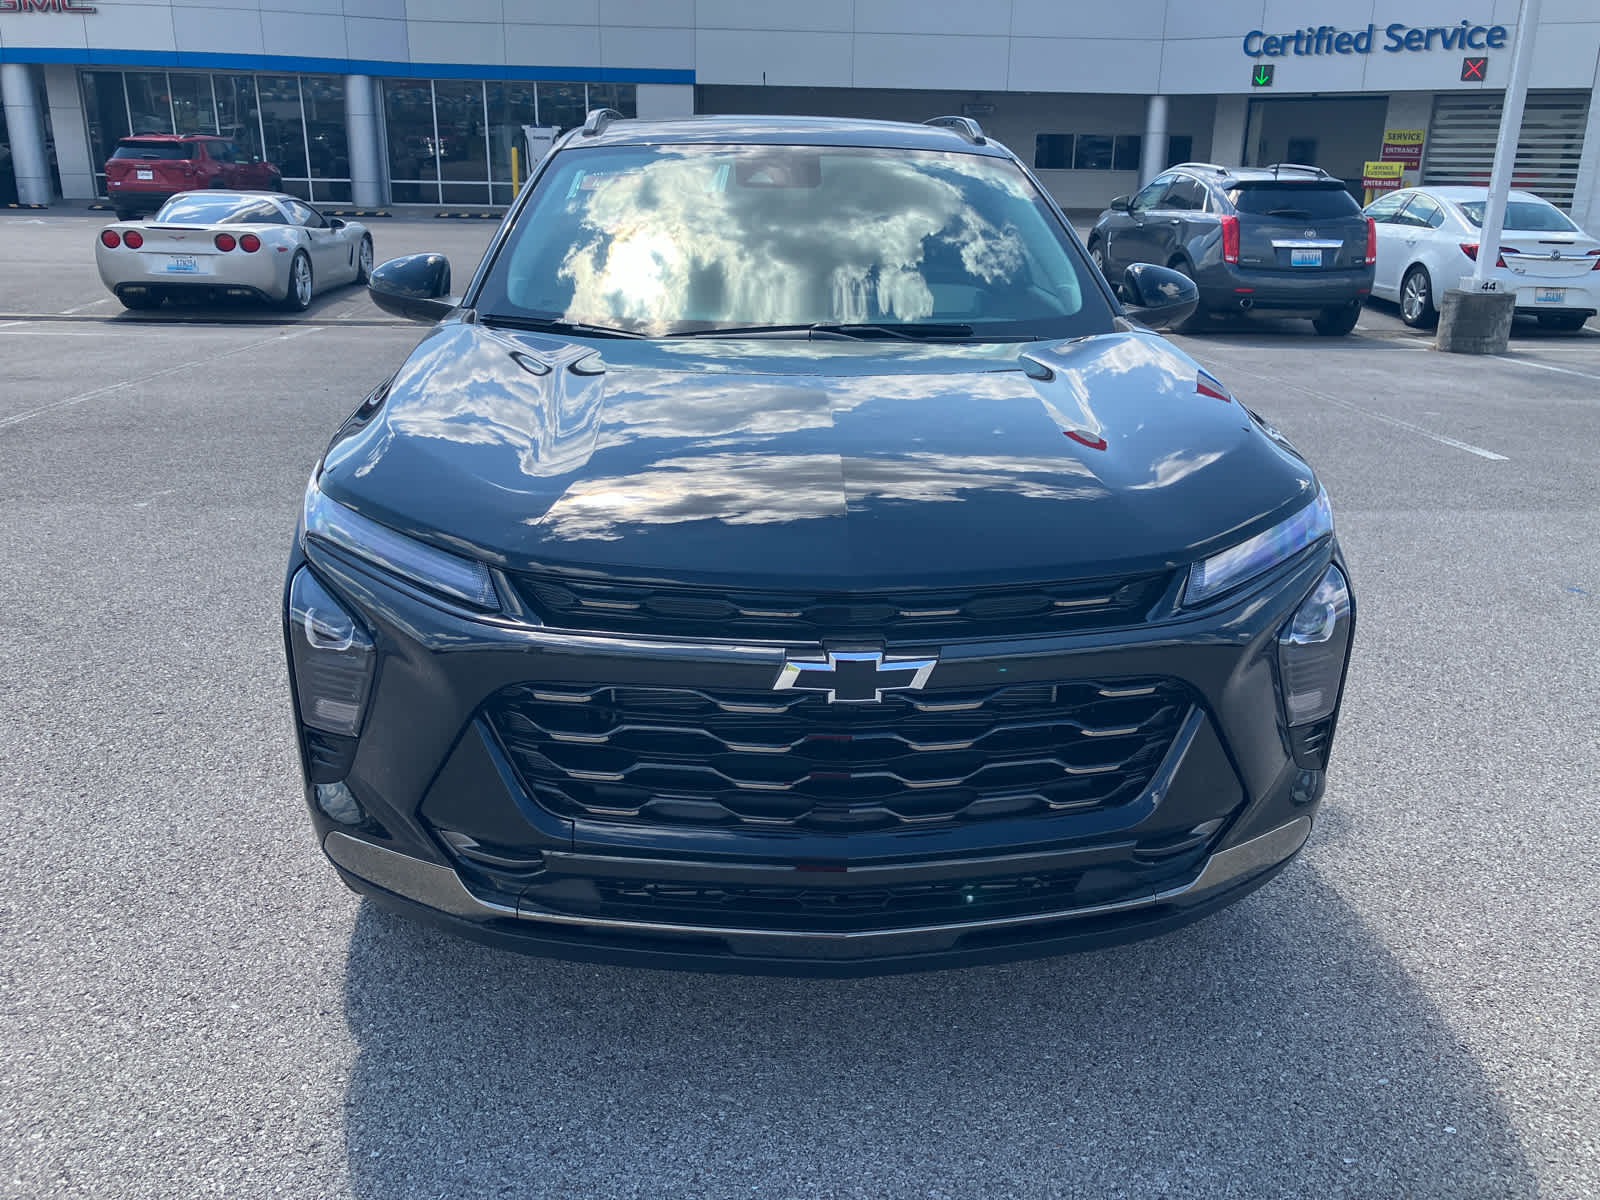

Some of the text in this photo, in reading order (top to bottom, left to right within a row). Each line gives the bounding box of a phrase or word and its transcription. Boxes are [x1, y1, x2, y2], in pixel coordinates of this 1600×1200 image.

[1243, 20, 1507, 57] Certified Service
[1387, 132, 1422, 141] SERVICE
[1481, 281, 1496, 291] 44
